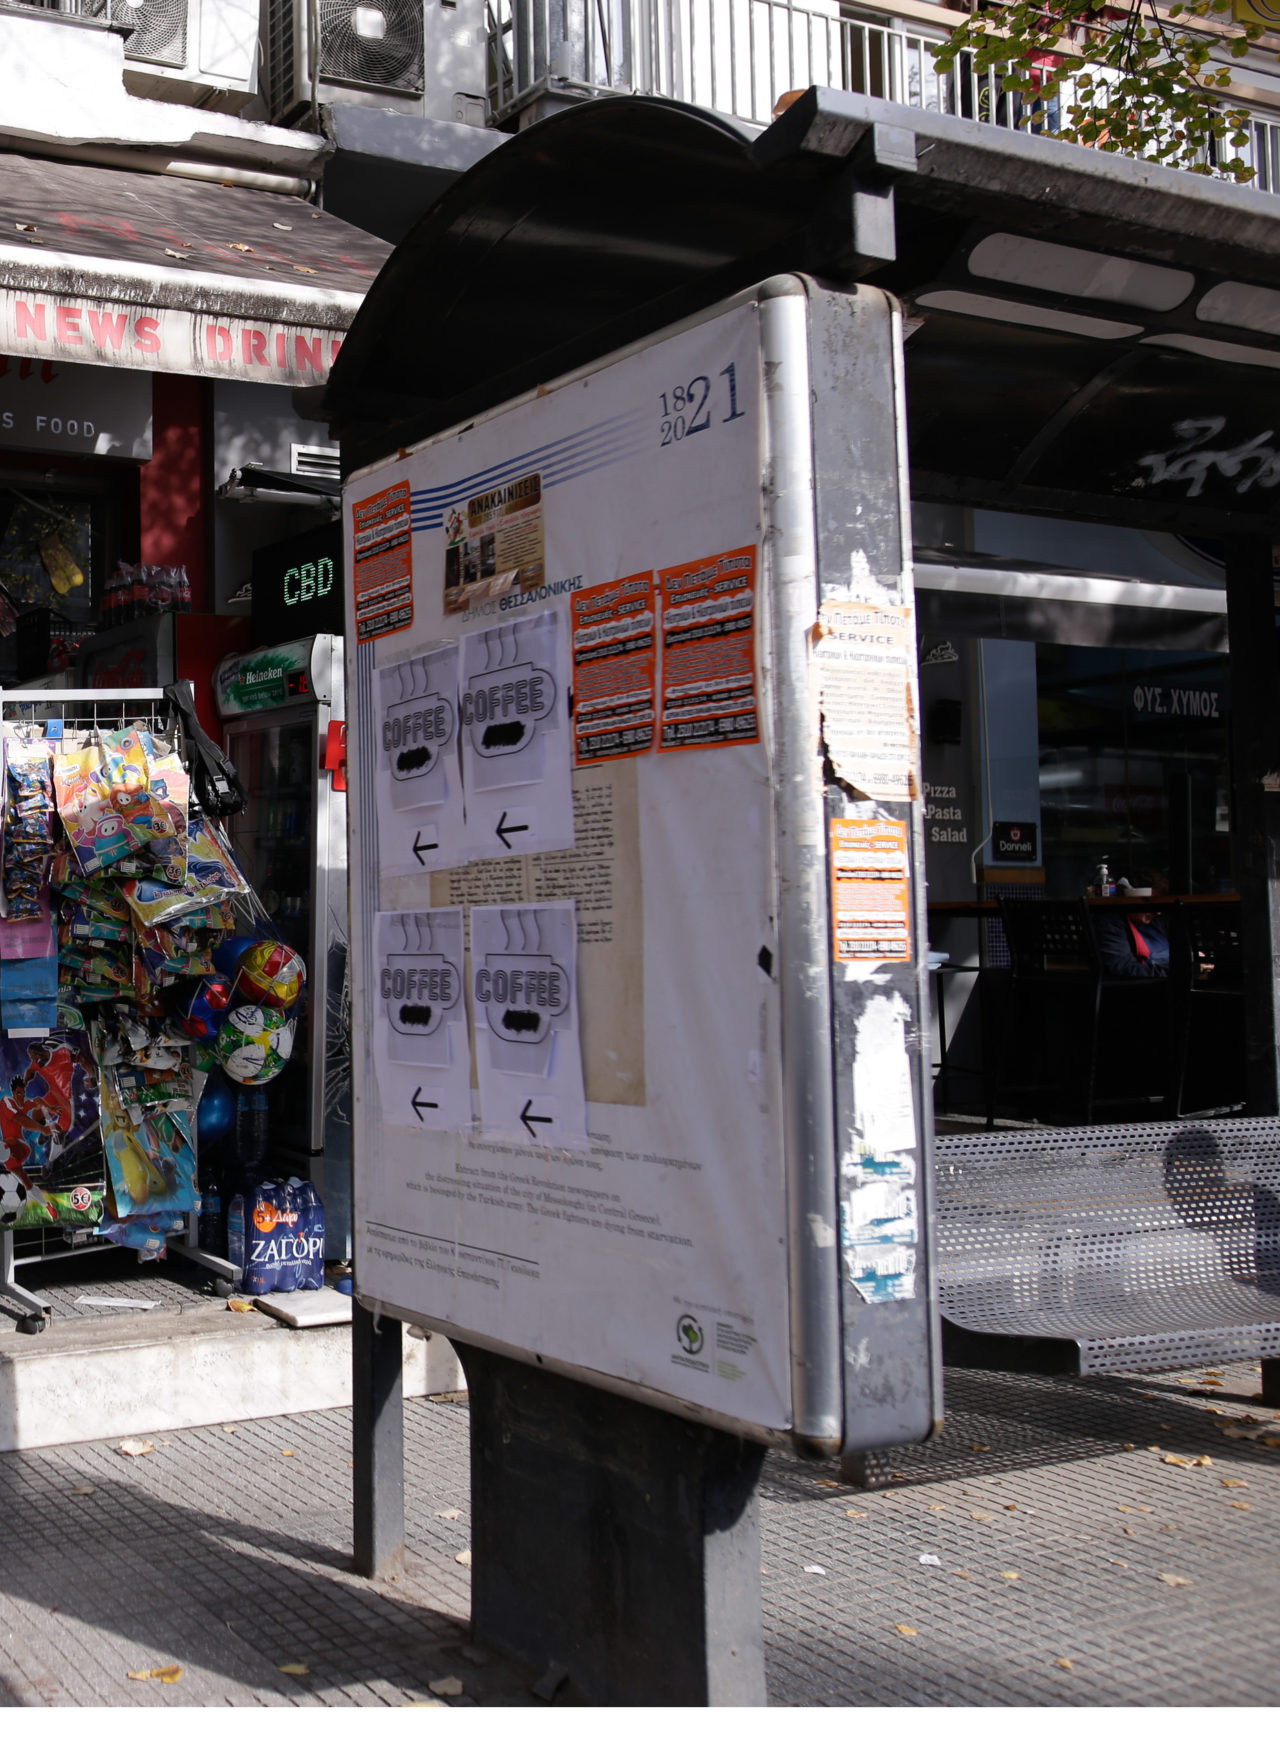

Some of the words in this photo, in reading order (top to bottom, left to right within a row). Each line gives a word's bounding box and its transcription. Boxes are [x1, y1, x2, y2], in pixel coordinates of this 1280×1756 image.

[16, 300, 162, 354] NEWS
[206, 323, 343, 374] DRIN
[36, 415, 96, 439] FOOD
[284, 557, 333, 606] CBD
[499, 575, 583, 610] ΘΕΣΣΑΛΟΝΙΚΗΣ
[715, 575, 748, 592] SERVICE
[618, 599, 646, 615] SERVICE
[829, 631, 894, 645] SERVICE
[246, 665, 283, 685] Heineken
[462, 676, 544, 726] COFFEE
[1133, 685, 1168, 714] ΦΥΣ.
[1170, 687, 1219, 718] ΧΥΜΟΣ
[382, 704, 445, 752] COFFEE
[923, 782, 956, 798] Pizza
[927, 804, 962, 820] Pasta
[931, 826, 967, 842] Salad
[381, 968, 452, 1002] COFFEE
[475, 969, 561, 1007] COFFEE
[73, 1195, 90, 1205] 5€
